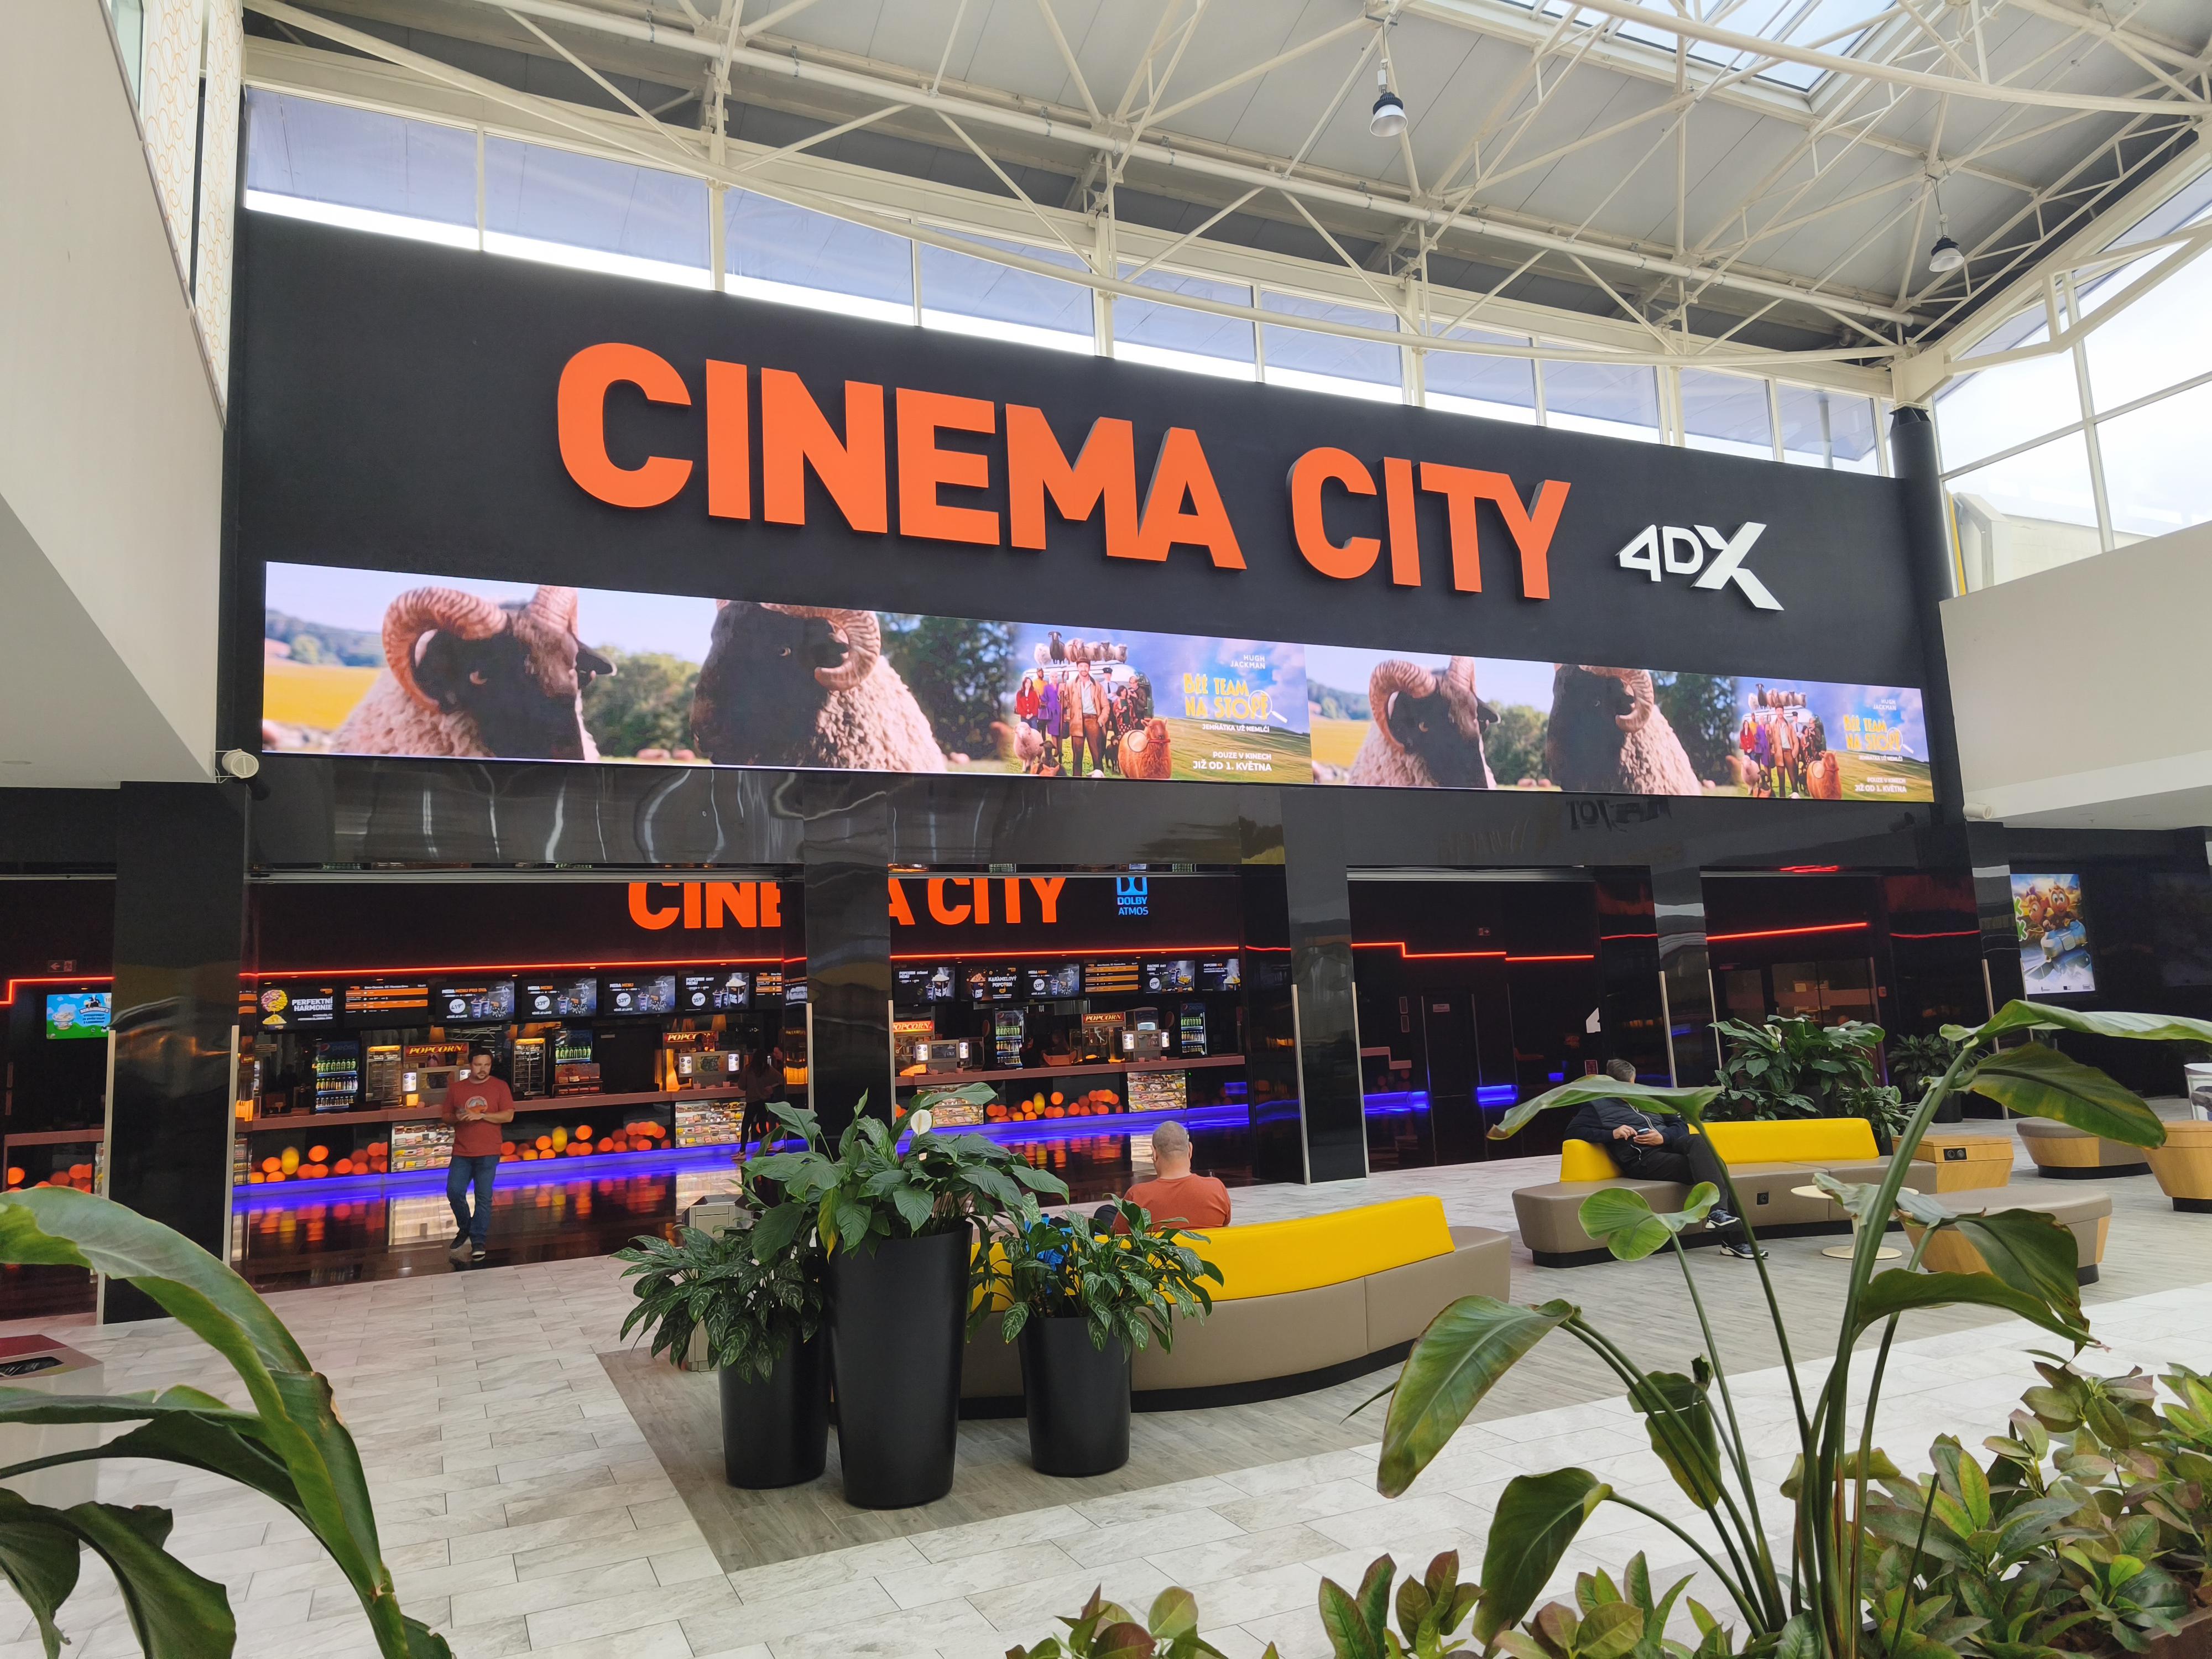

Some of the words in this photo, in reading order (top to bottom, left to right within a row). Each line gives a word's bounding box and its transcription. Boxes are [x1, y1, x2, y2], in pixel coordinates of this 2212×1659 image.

[557, 342, 1247, 570] CINEMA
[1286, 446, 1571, 599] CITY
[1615, 521, 1784, 611] 4DX
[1230, 661, 1265, 669] JACKMAN
[1213, 677, 1250, 697] TEAM
[1185, 696, 1208, 717] NA
[1845, 733, 1862, 749] NA
[1193, 759, 1207, 769] JIŽ
[1208, 761, 1223, 770] OD
[1225, 762, 1234, 770] 1.
[1236, 761, 1272, 771] KVĚTNA
[1117, 896, 1147, 905] DOLBY
[1118, 906, 1149, 915] ATMOS
[292, 996, 333, 1006] PERFEKTNÍ
[1085, 1014, 1122, 1022] POPCORN
[409, 1044, 464, 1055] POPCORN
